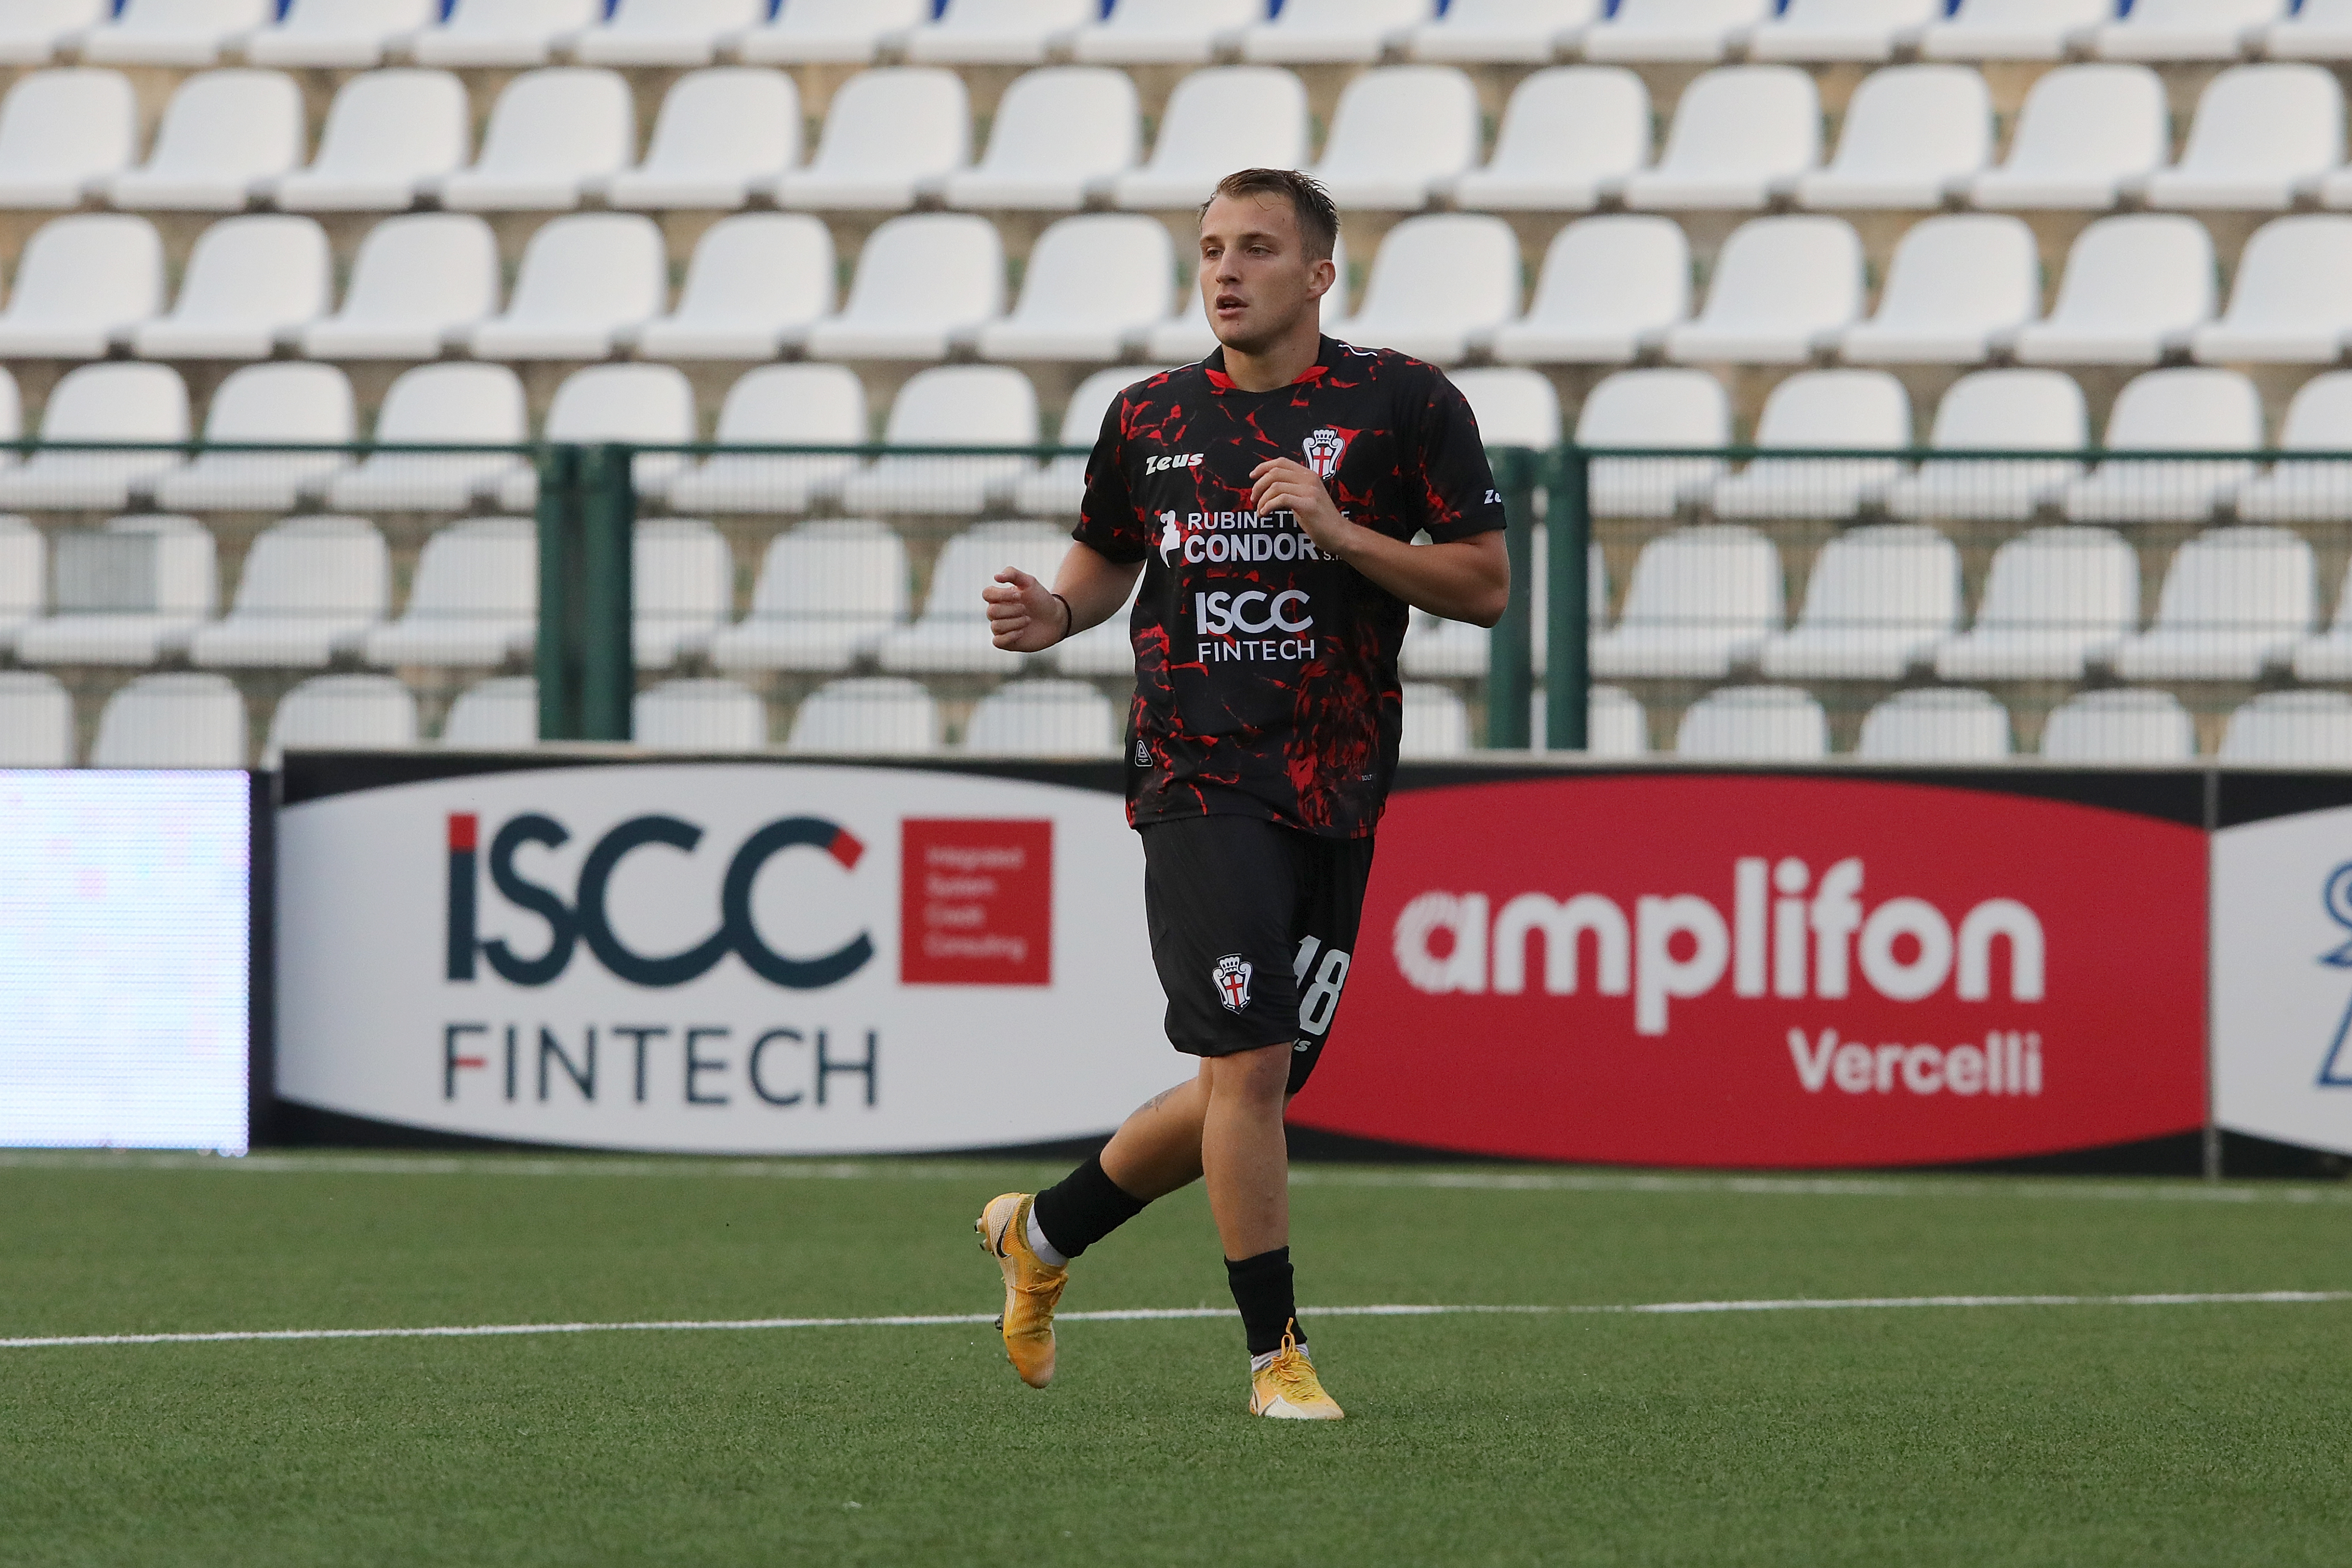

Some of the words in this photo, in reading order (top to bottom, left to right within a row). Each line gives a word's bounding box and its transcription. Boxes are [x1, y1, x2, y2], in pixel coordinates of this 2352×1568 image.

[1146, 453, 1204, 476] Zeus
[1484, 489, 1502, 504] Ze
[1184, 533, 1319, 563] CONDOR
[1195, 590, 1314, 635] ISCC
[1198, 639, 1315, 663] FINTECH
[1393, 856, 2046, 1036] amplifon
[1293, 935, 1350, 1036] 18
[444, 1023, 878, 1107] FINTECH
[1786, 1027, 2043, 1096] Vercelli
